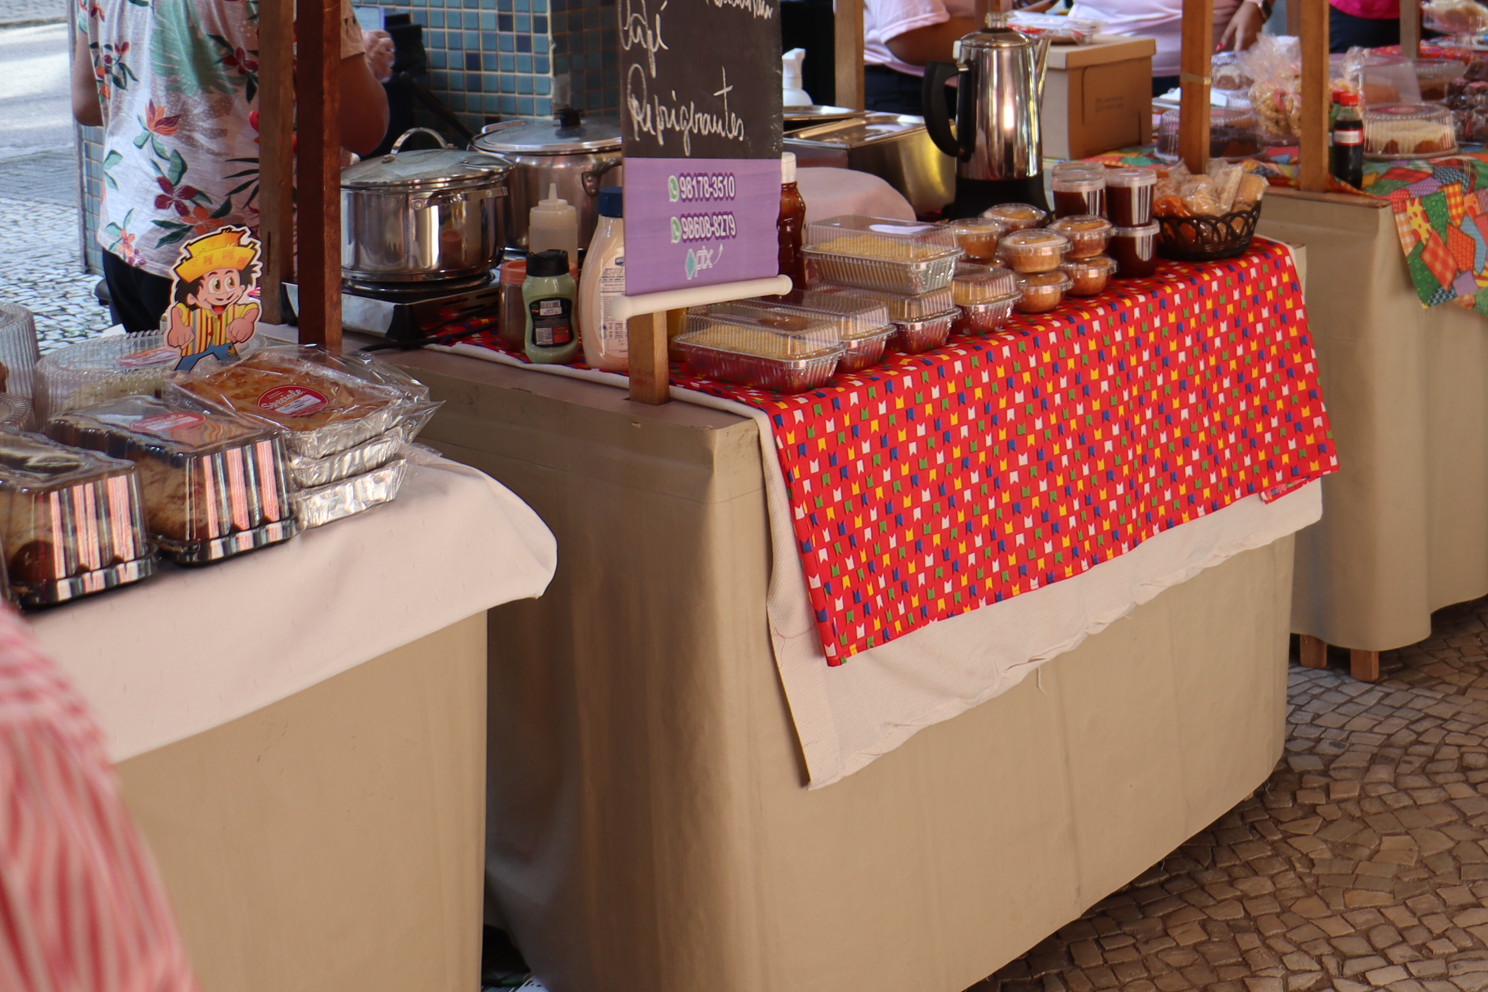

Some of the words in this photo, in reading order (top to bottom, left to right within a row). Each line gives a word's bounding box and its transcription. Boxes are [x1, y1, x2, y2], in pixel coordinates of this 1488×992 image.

[679, 174, 735, 201] 98178-3510
[681, 213, 736, 240] 98608-8279
[695, 245, 714, 278] pix
